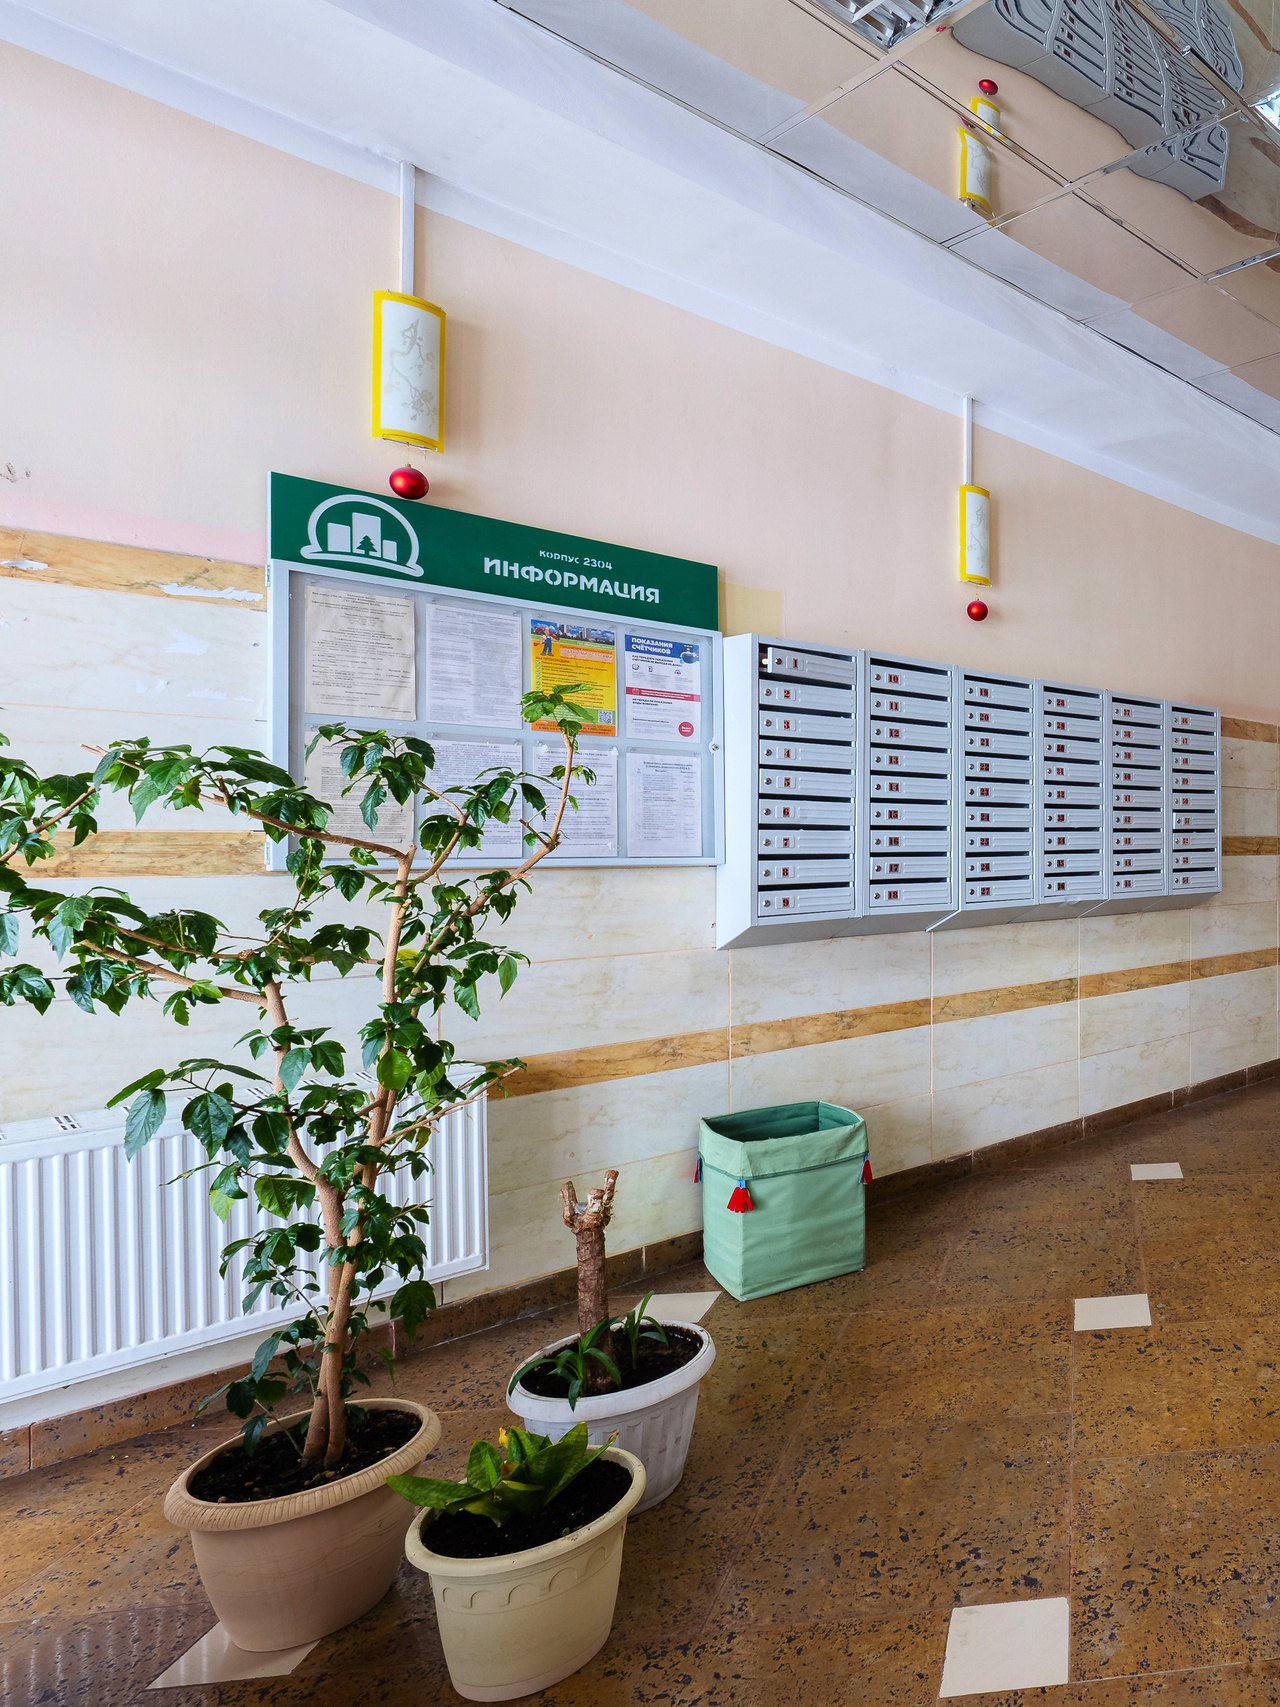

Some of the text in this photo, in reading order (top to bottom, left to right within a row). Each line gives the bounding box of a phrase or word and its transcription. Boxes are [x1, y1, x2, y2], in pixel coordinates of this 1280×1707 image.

[583, 557, 613, 570] 2304
[483, 557, 660, 604] ИНФОРМАЦИЯ
[631, 637, 673, 648] ПОКАЗАНИЯ
[631, 643, 671, 654] СЧЁТЧИКОВ
[792, 658, 798, 669] 1
[888, 673, 899, 684] 10
[783, 689, 791, 699] 2
[979, 687, 989, 697] 19
[889, 701, 899, 711] 11
[978, 712, 990, 722] 20
[783, 719, 791, 730] 3
[889, 728, 900, 738] 12
[979, 738, 989, 747] 21
[783, 748, 791, 759] 4
[888, 755, 899, 765] 13
[979, 762, 990, 772] 22
[783, 777, 791, 787] 5
[888, 782, 899, 792] 14
[979, 787, 990, 796] 23
[782, 807, 790, 817] 6
[887, 809, 898, 819] 15
[782, 837, 790, 848] 7
[888, 836, 900, 846] 16
[781, 867, 789, 877] 8
[889, 863, 899, 873] 17
[887, 890, 899, 900] 18
[781, 897, 790, 908] 9
